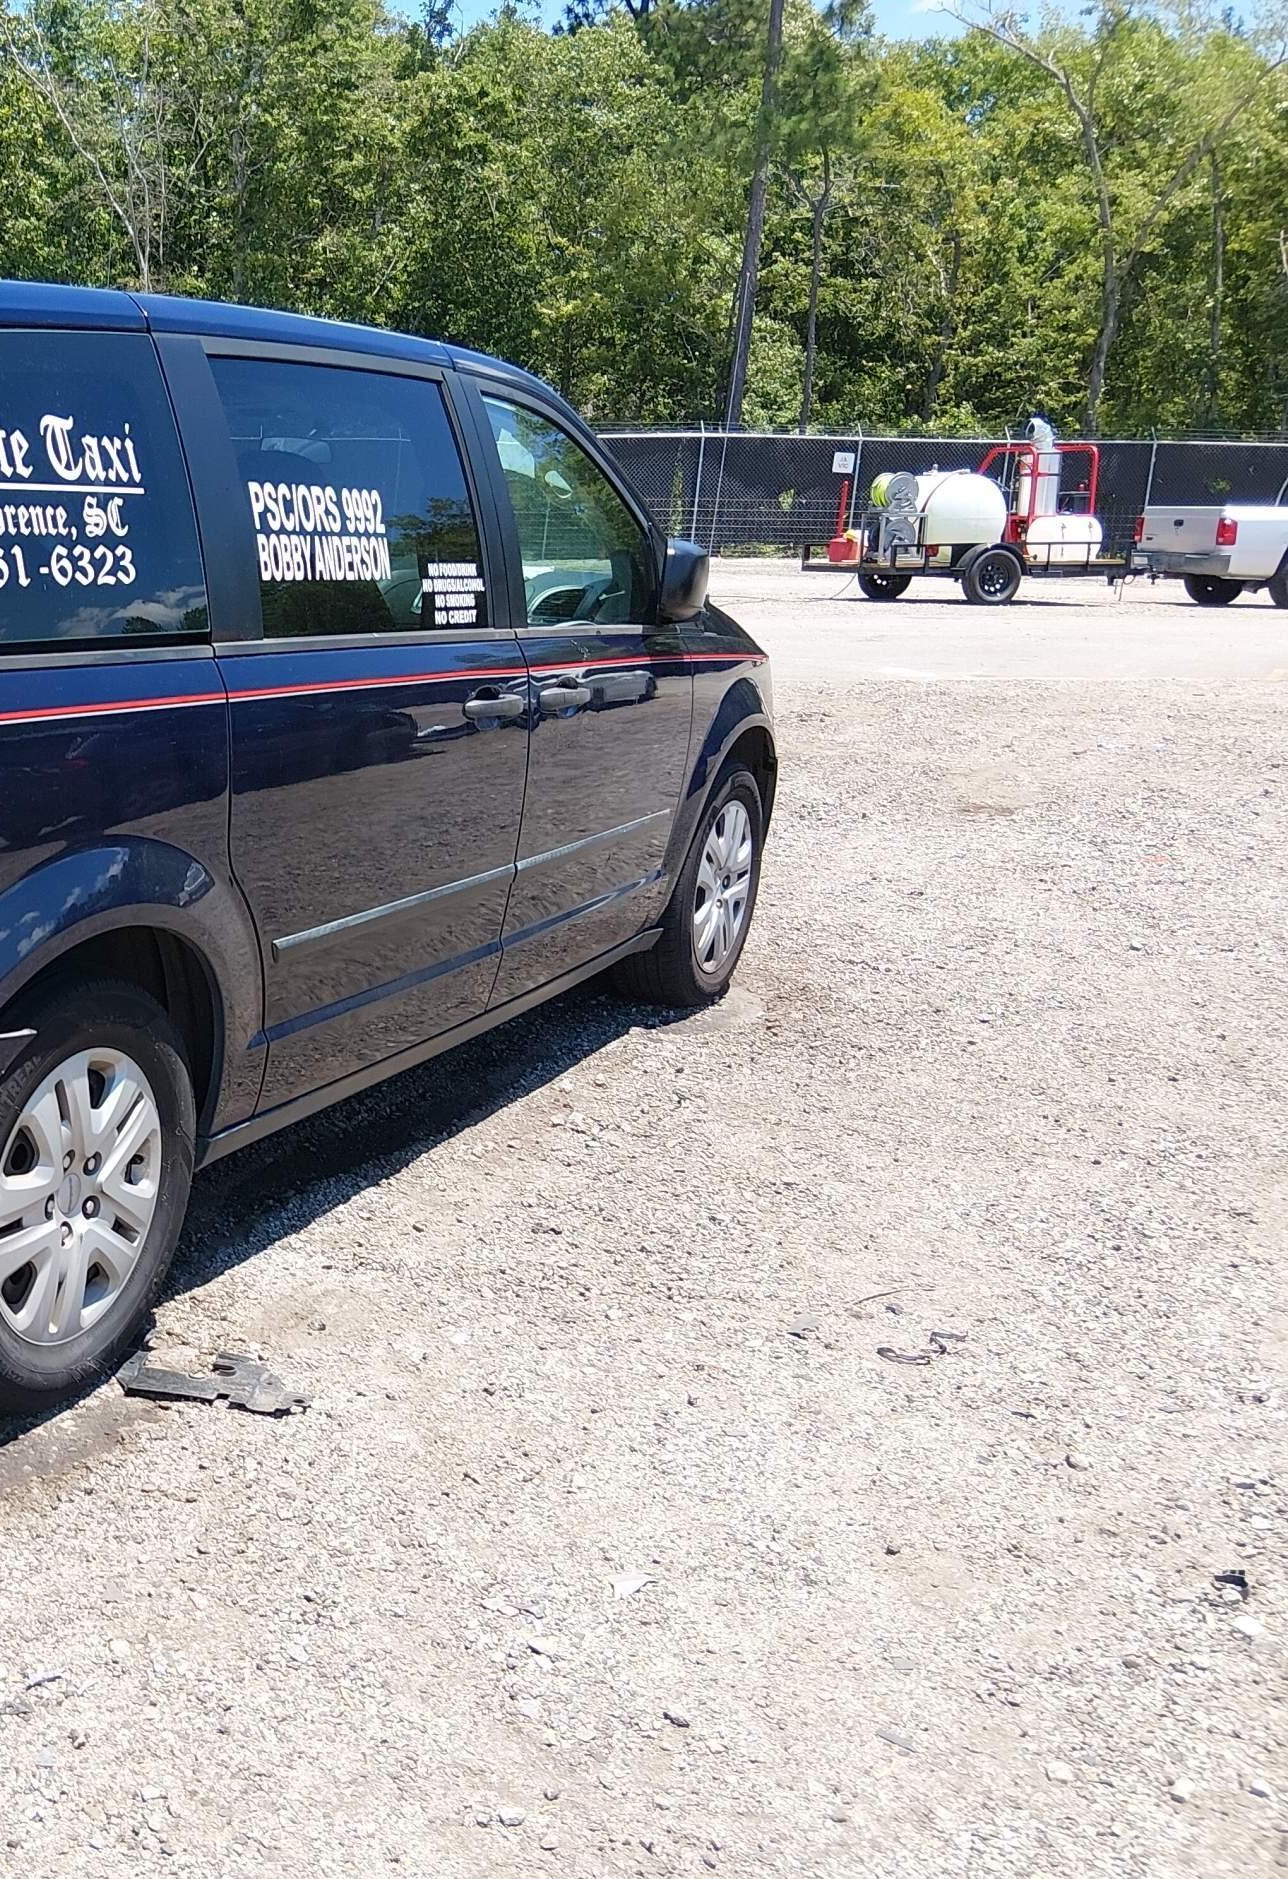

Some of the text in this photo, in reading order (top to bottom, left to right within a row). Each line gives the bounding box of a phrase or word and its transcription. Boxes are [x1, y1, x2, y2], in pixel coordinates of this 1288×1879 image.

[39, 414, 142, 484] Taxi
[83, 495, 129, 538] SC
[341, 487, 386, 534] 9992
[256, 533, 392, 582] BOBBY ANDERSON
[427, 563, 439, 577] NO
[422, 579, 433, 593] NO
[434, 593, 475, 609] NO SMOKING
[434, 609, 477, 625] NO CREDIT
